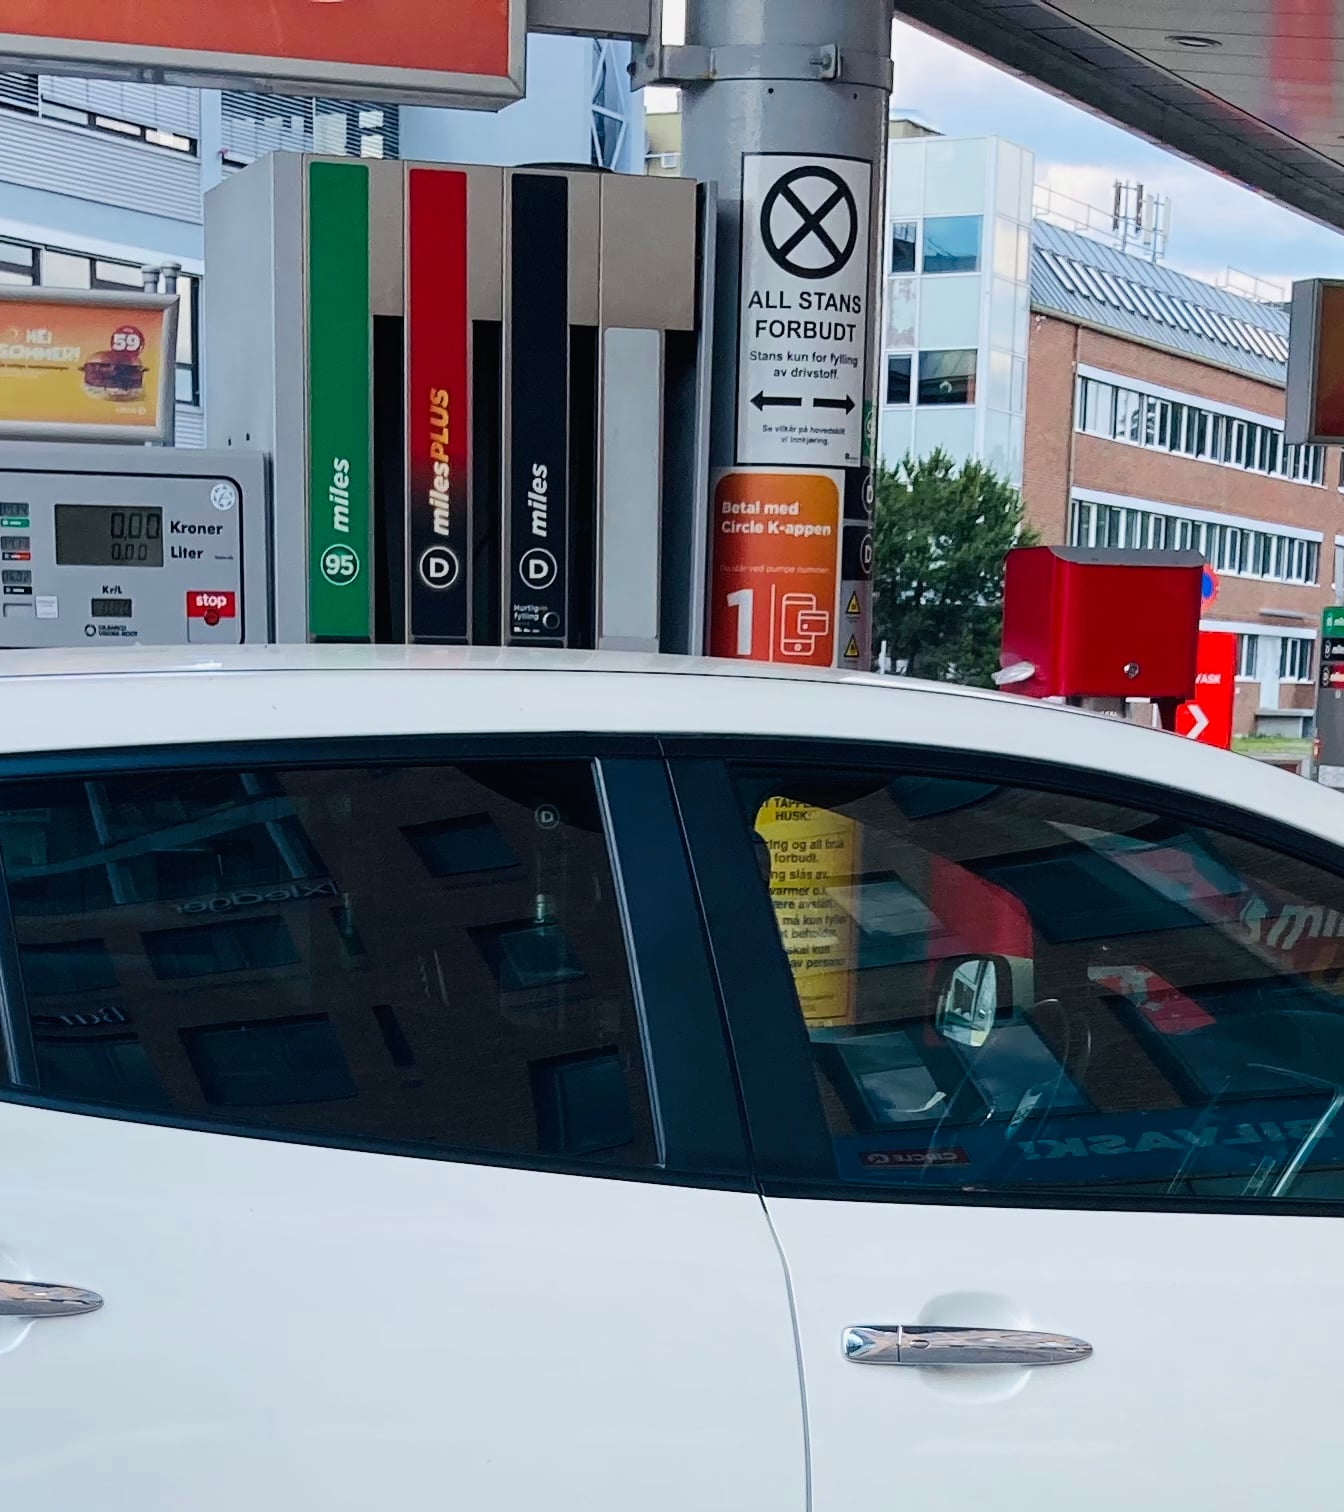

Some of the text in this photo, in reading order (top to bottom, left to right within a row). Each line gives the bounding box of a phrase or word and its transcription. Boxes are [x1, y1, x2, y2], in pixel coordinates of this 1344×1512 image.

[748, 291, 862, 314] ALL STANS
[756, 320, 857, 342] FORBUDT
[113, 333, 141, 351] 59
[749, 351, 783, 361] Stans
[787, 351, 808, 362] kun
[812, 352, 827, 363] for
[773, 369, 787, 378] av
[429, 387, 450, 536] milesPLUS
[329, 457, 350, 533] miles
[527, 463, 548, 537] miles
[722, 501, 799, 515] Betal med
[170, 520, 223, 535] Kroner
[721, 520, 832, 537] Circle K-appen
[171, 546, 203, 559] Liter
[326, 554, 354, 576] 95
[429, 558, 450, 577] D
[529, 559, 549, 579] D
[102, 585, 122, 594] Kr/L
[196, 594, 227, 608] stop
[726, 589, 754, 656] 1
[792, 841, 807, 851] og
[810, 840, 822, 849] all
